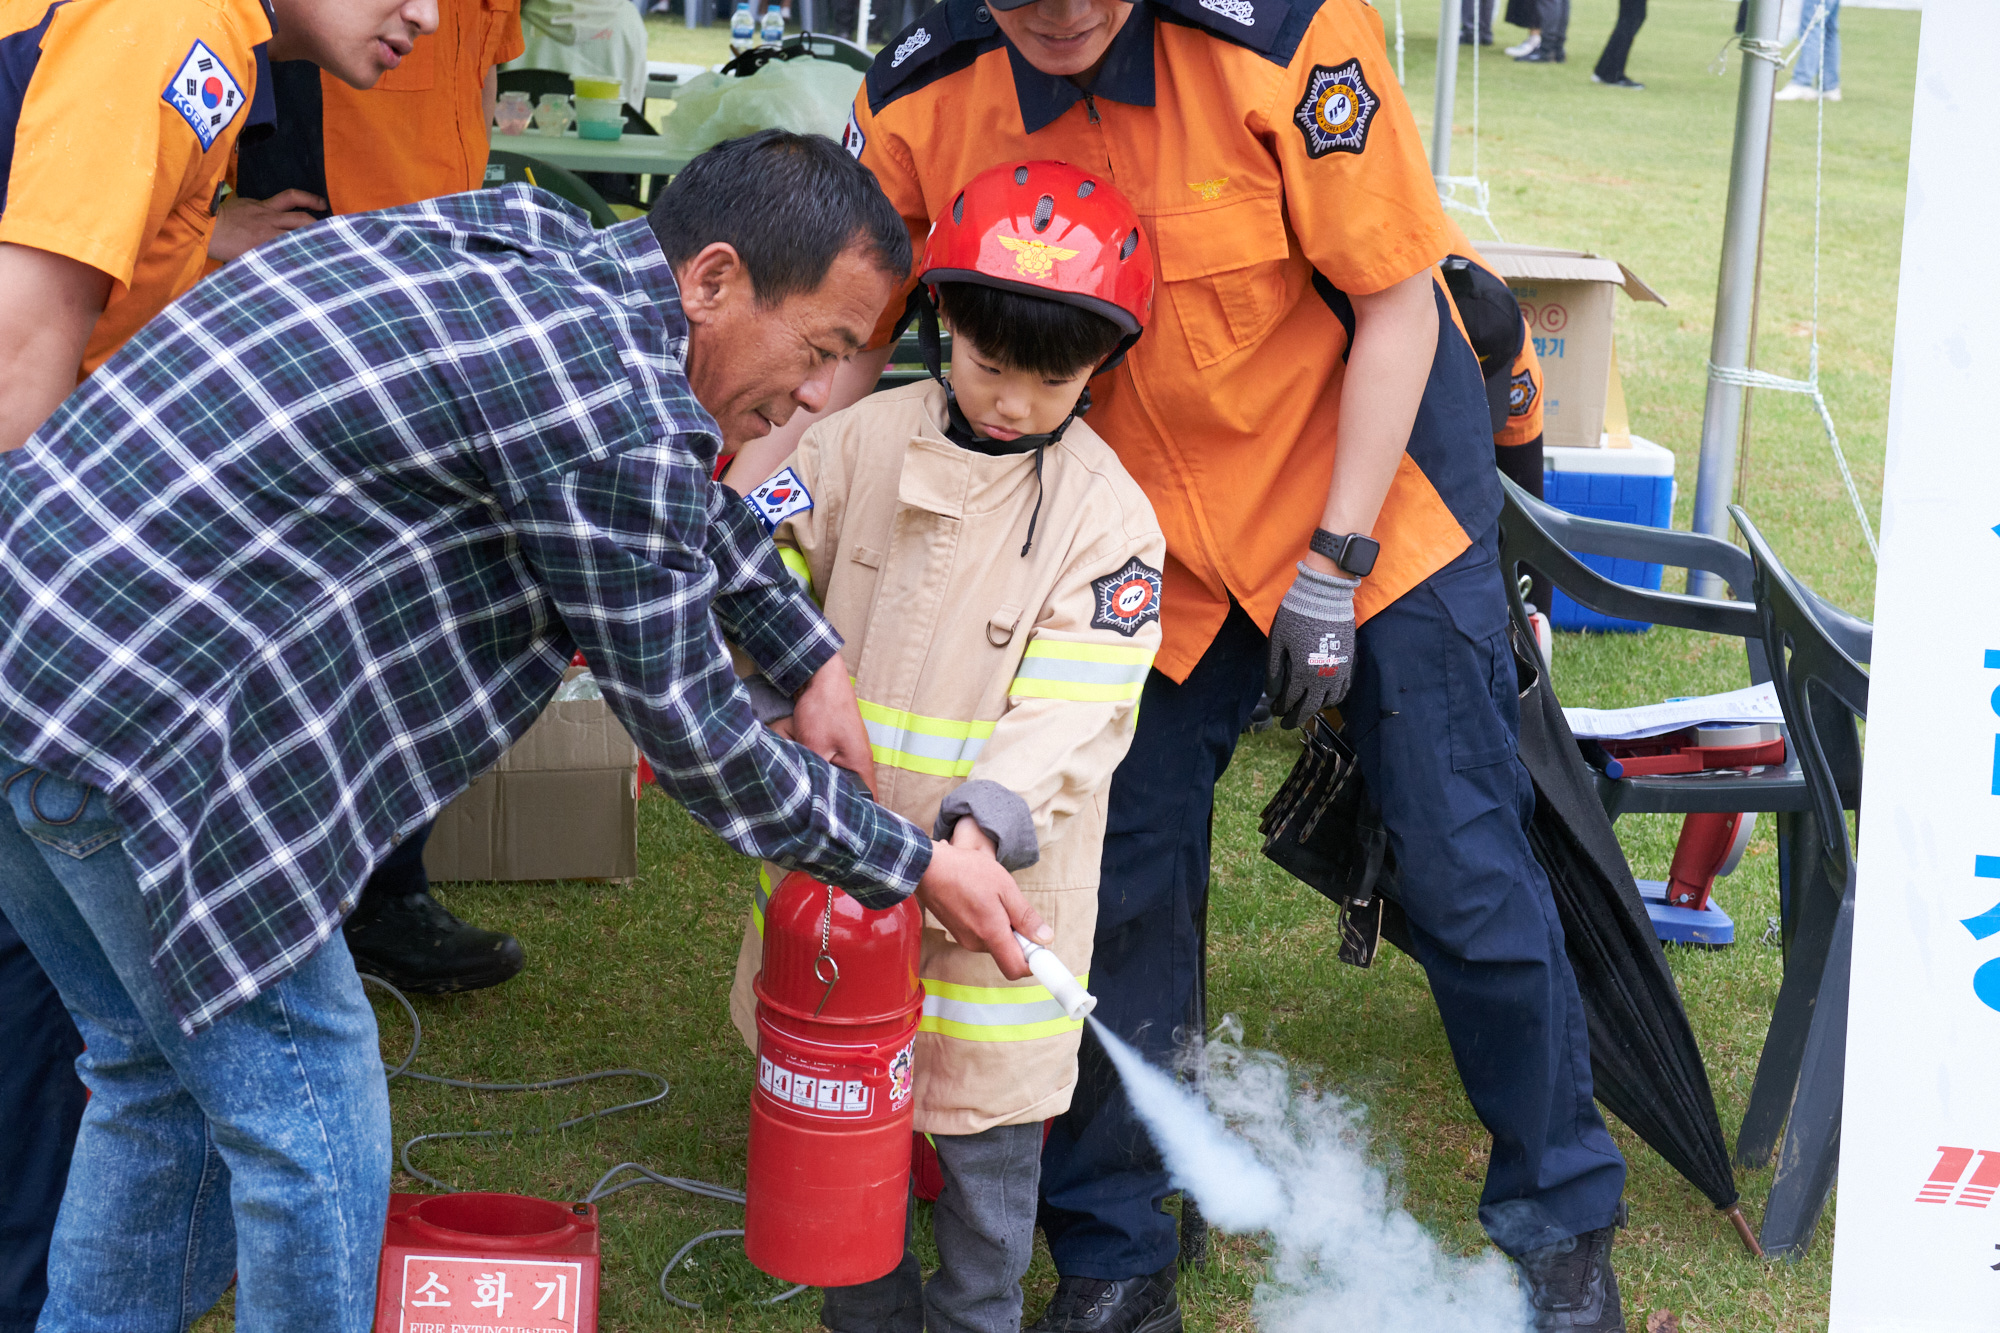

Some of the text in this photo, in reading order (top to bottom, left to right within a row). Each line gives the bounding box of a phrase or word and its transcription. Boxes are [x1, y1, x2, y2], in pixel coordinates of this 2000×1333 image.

[1328, 96, 1347, 121] 119
[172, 92, 212, 144] KOREA
[1323, 122, 1340, 133] KOREA
[1340, 122, 1351, 132] FIRE
[1121, 590, 1144, 606] 119
[409, 1322, 446, 1333] FIRE
